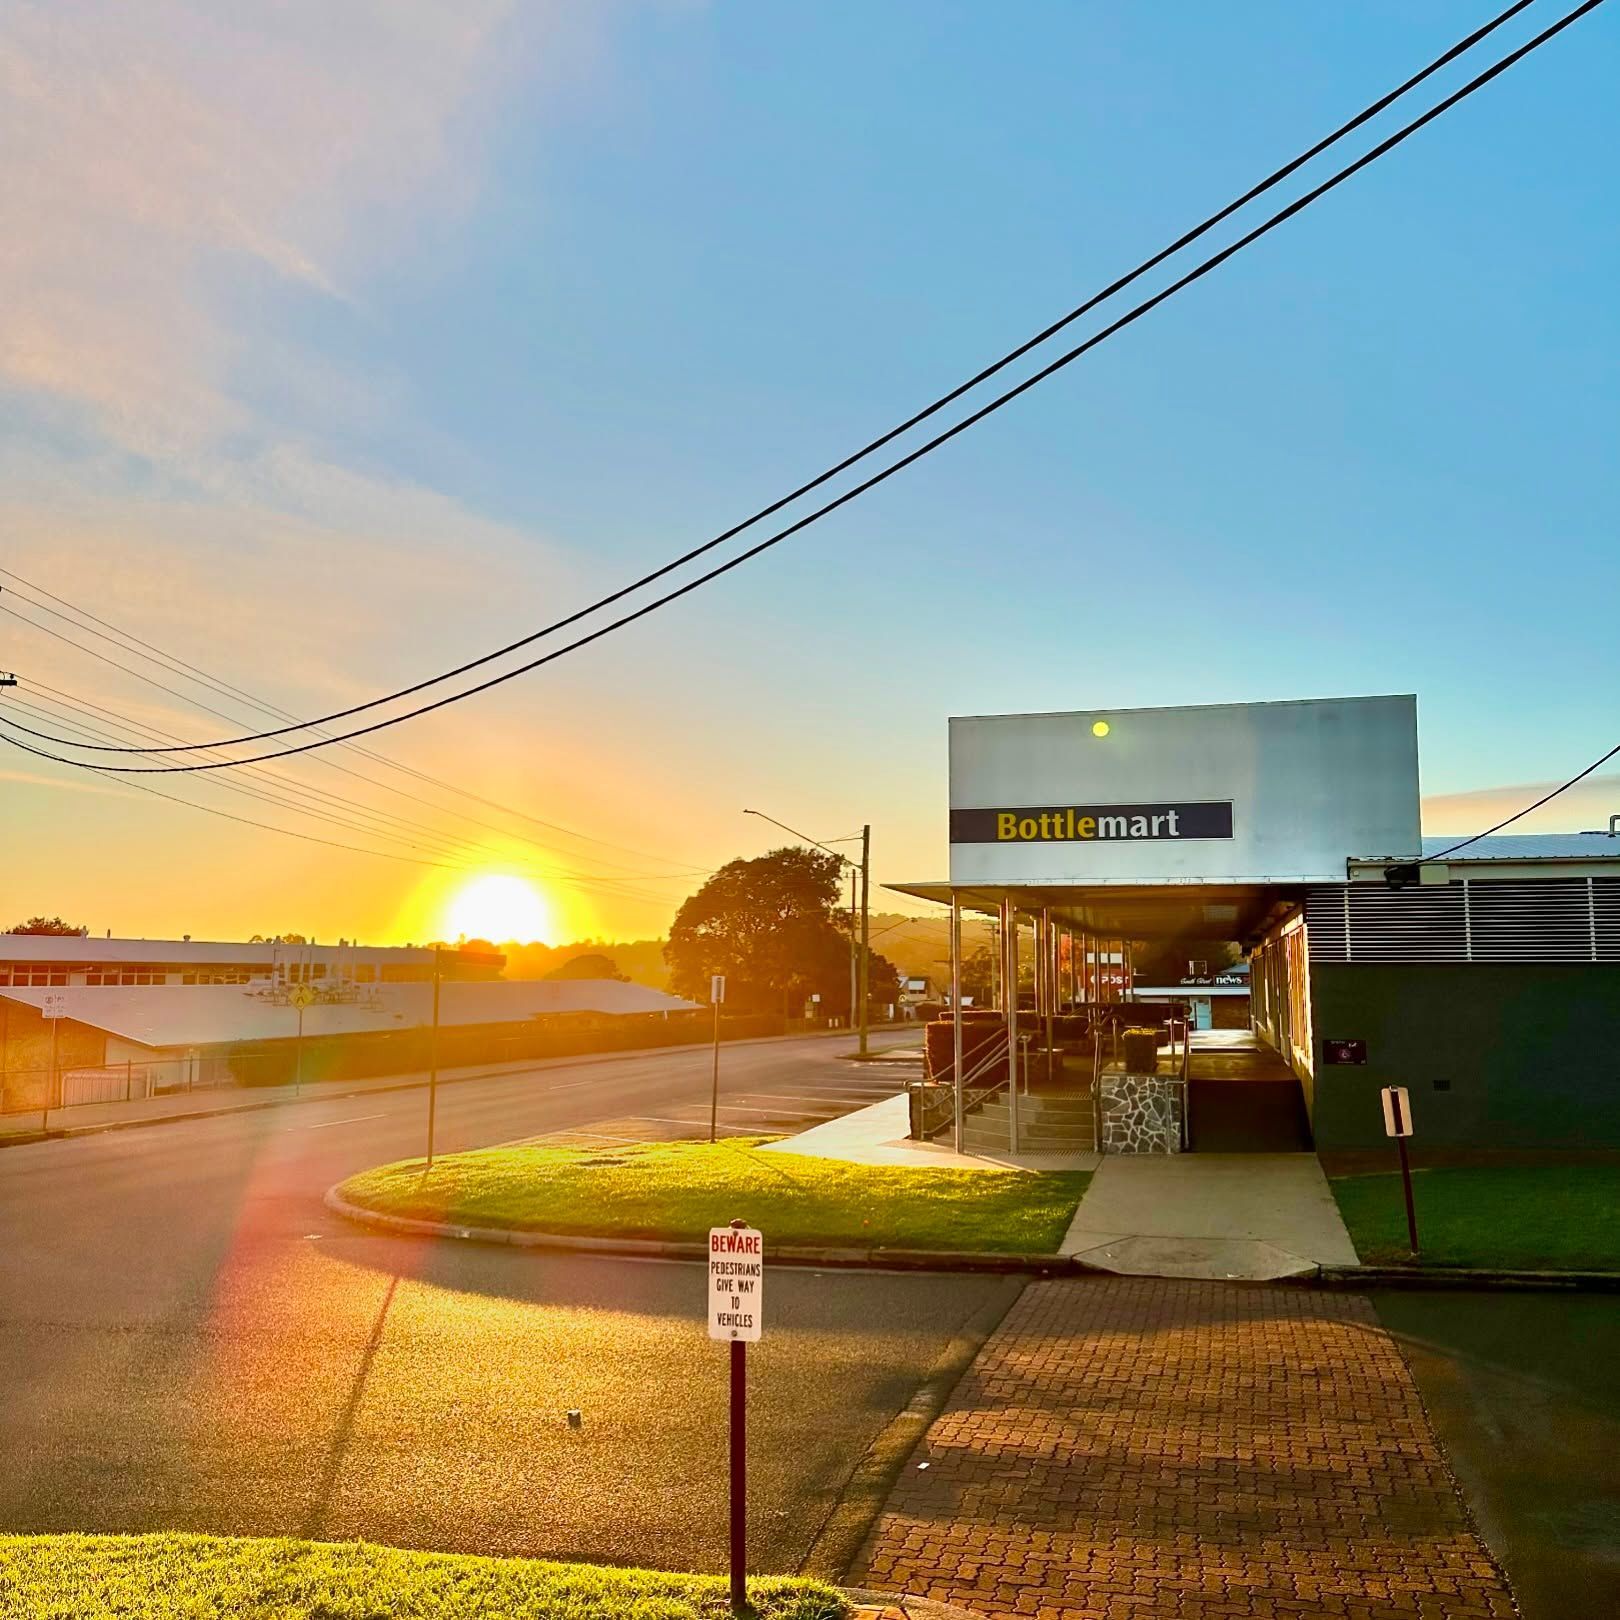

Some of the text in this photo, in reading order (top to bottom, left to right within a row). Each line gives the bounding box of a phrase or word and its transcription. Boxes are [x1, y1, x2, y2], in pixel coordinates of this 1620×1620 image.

[997, 808, 1180, 840] Bottlemart
[1216, 974, 1243, 985] news
[711, 1235, 760, 1254] BEWARE
[711, 1261, 760, 1277] PEDESTRIANS
[716, 1278, 754, 1293] GIVE WAY
[731, 1296, 740, 1310] TO
[717, 1312, 753, 1328] VEHICLES
